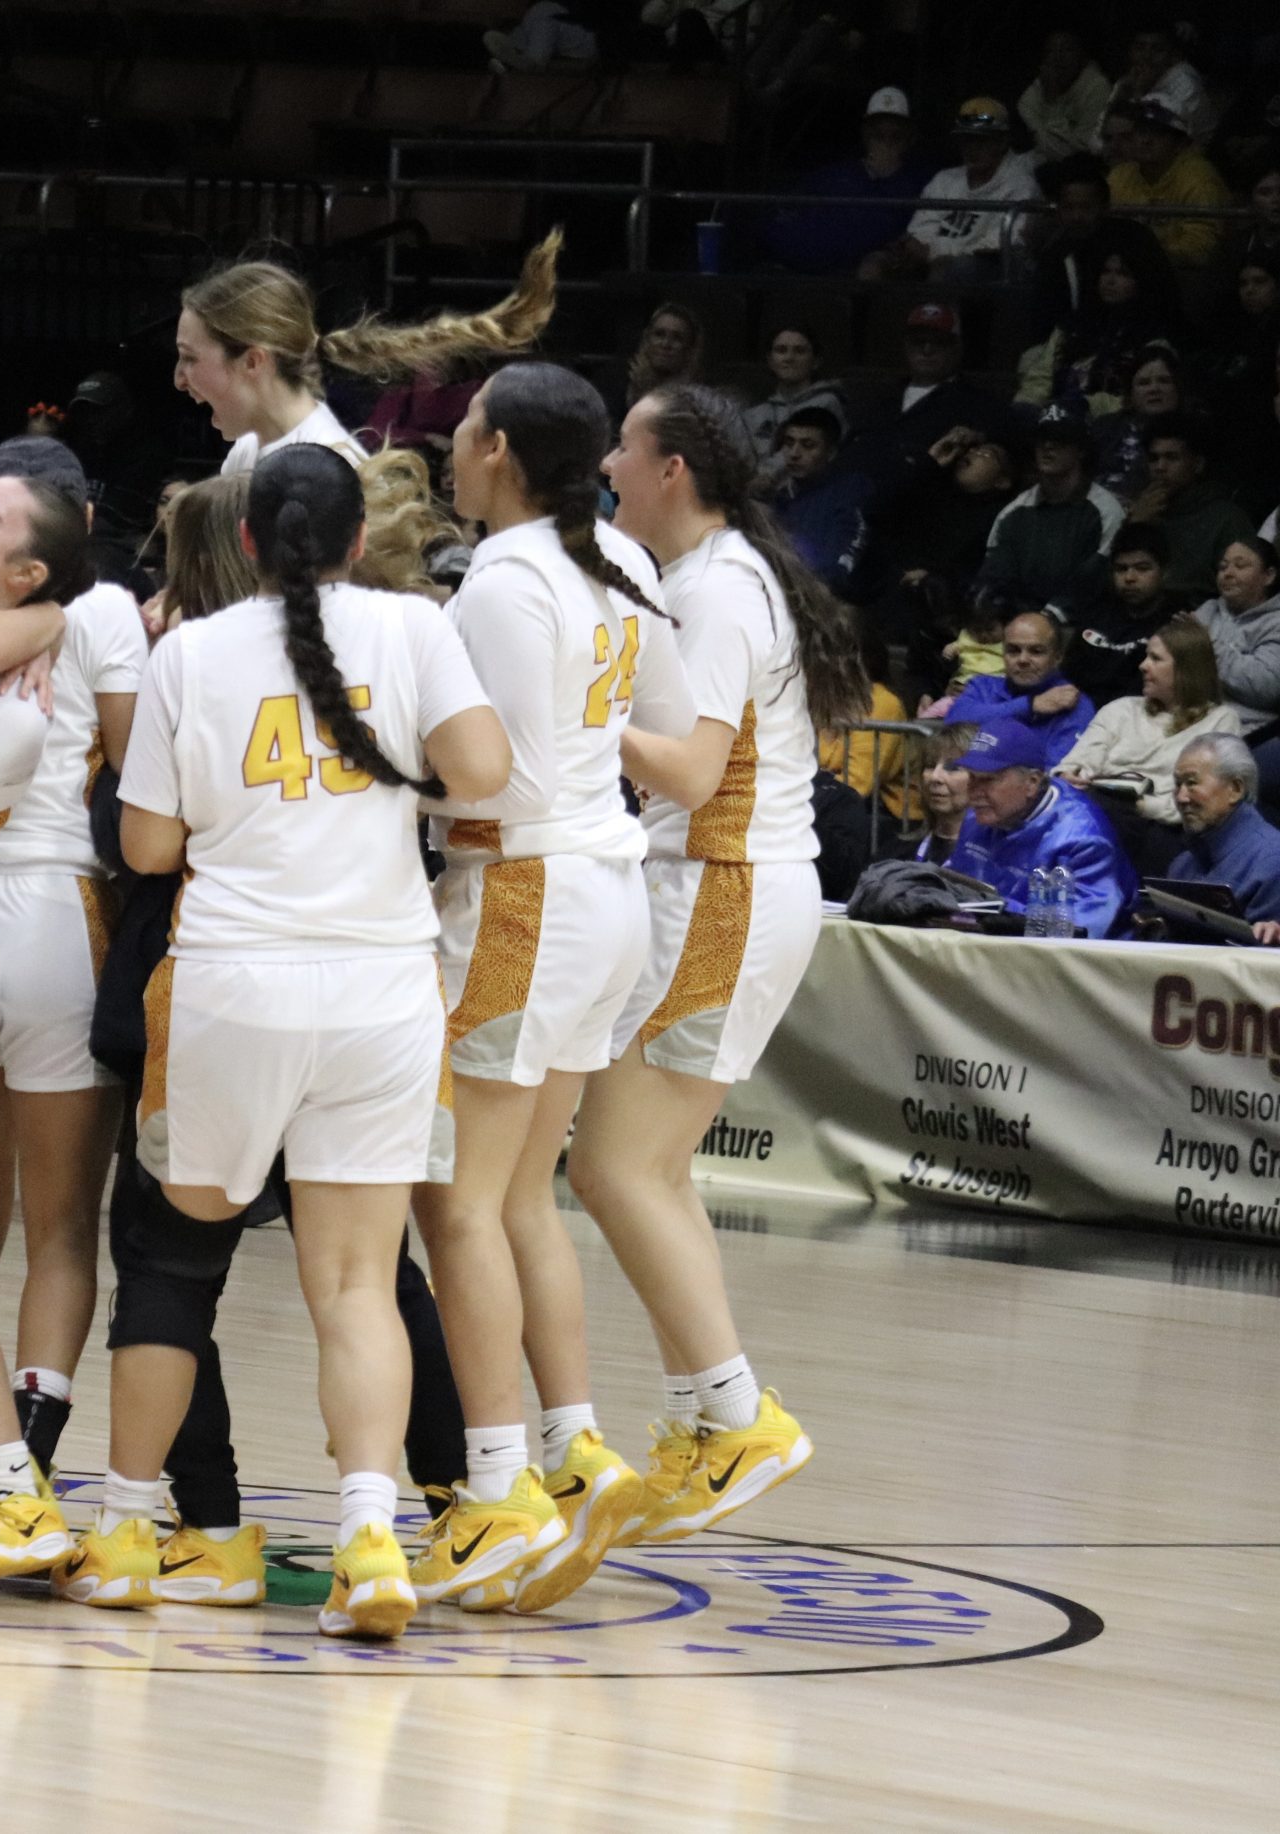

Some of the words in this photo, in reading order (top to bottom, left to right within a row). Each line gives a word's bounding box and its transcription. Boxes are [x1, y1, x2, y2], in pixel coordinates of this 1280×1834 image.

[583, 614, 639, 729] 24
[915, 1054, 1012, 1091] DIVISION
[901, 1097, 968, 1141] Clovis
[973, 1105, 1032, 1150] West
[1190, 1085, 1280, 1122] DIVISIO
[900, 1151, 936, 1184] St.
[940, 1156, 1032, 1206] Joseph
[1155, 1127, 1239, 1181] Arroyo
[636, 1553, 992, 1647] FRESNO
